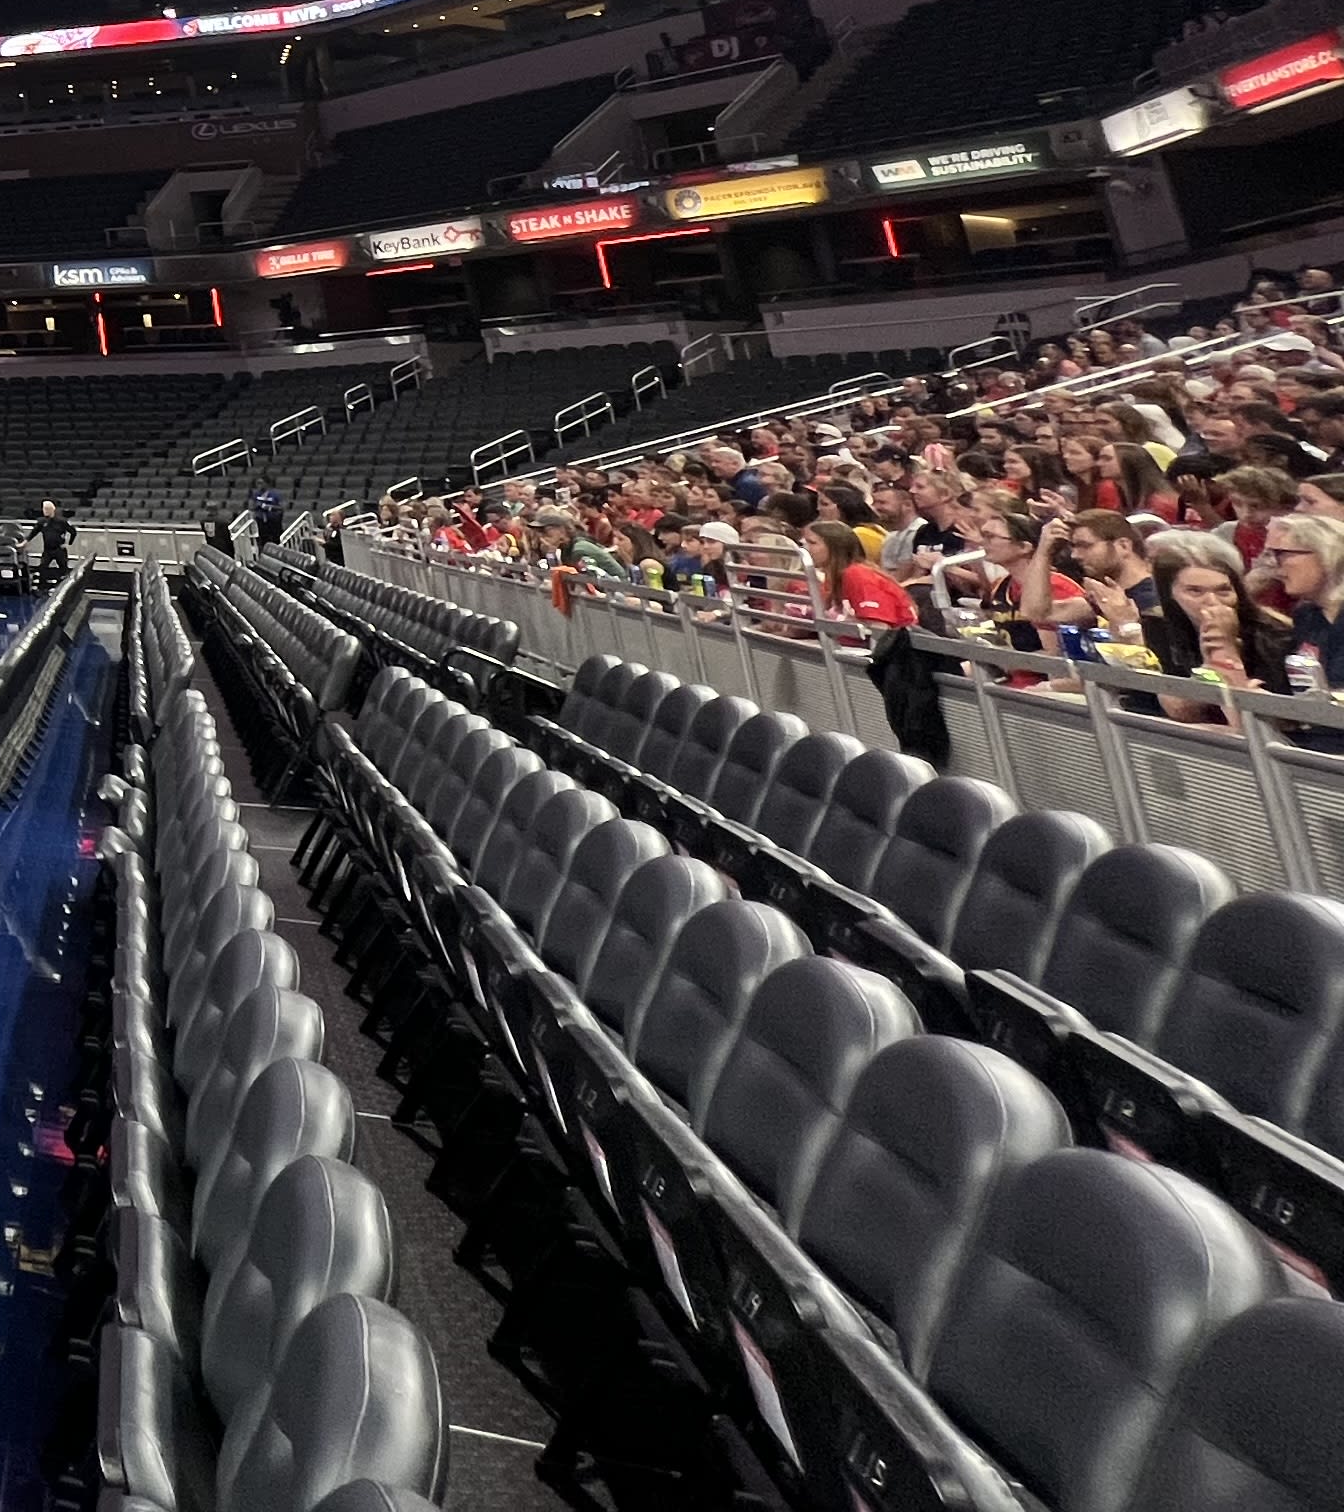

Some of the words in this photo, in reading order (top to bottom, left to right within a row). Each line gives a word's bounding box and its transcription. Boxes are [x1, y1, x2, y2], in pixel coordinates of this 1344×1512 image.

[198, 11, 281, 33] WELCOME
[283, 5, 328, 26] MVPs
[712, 39, 740, 58] DJ
[218, 118, 298, 135] LEXUS
[931, 152, 1033, 177] SUSTAINABILITY
[970, 143, 1027, 162] DRIVING
[509, 212, 561, 235] STEAK
[574, 204, 632, 226] SHAKE
[372, 232, 441, 260] KeyBank
[53, 264, 104, 287] ksm
